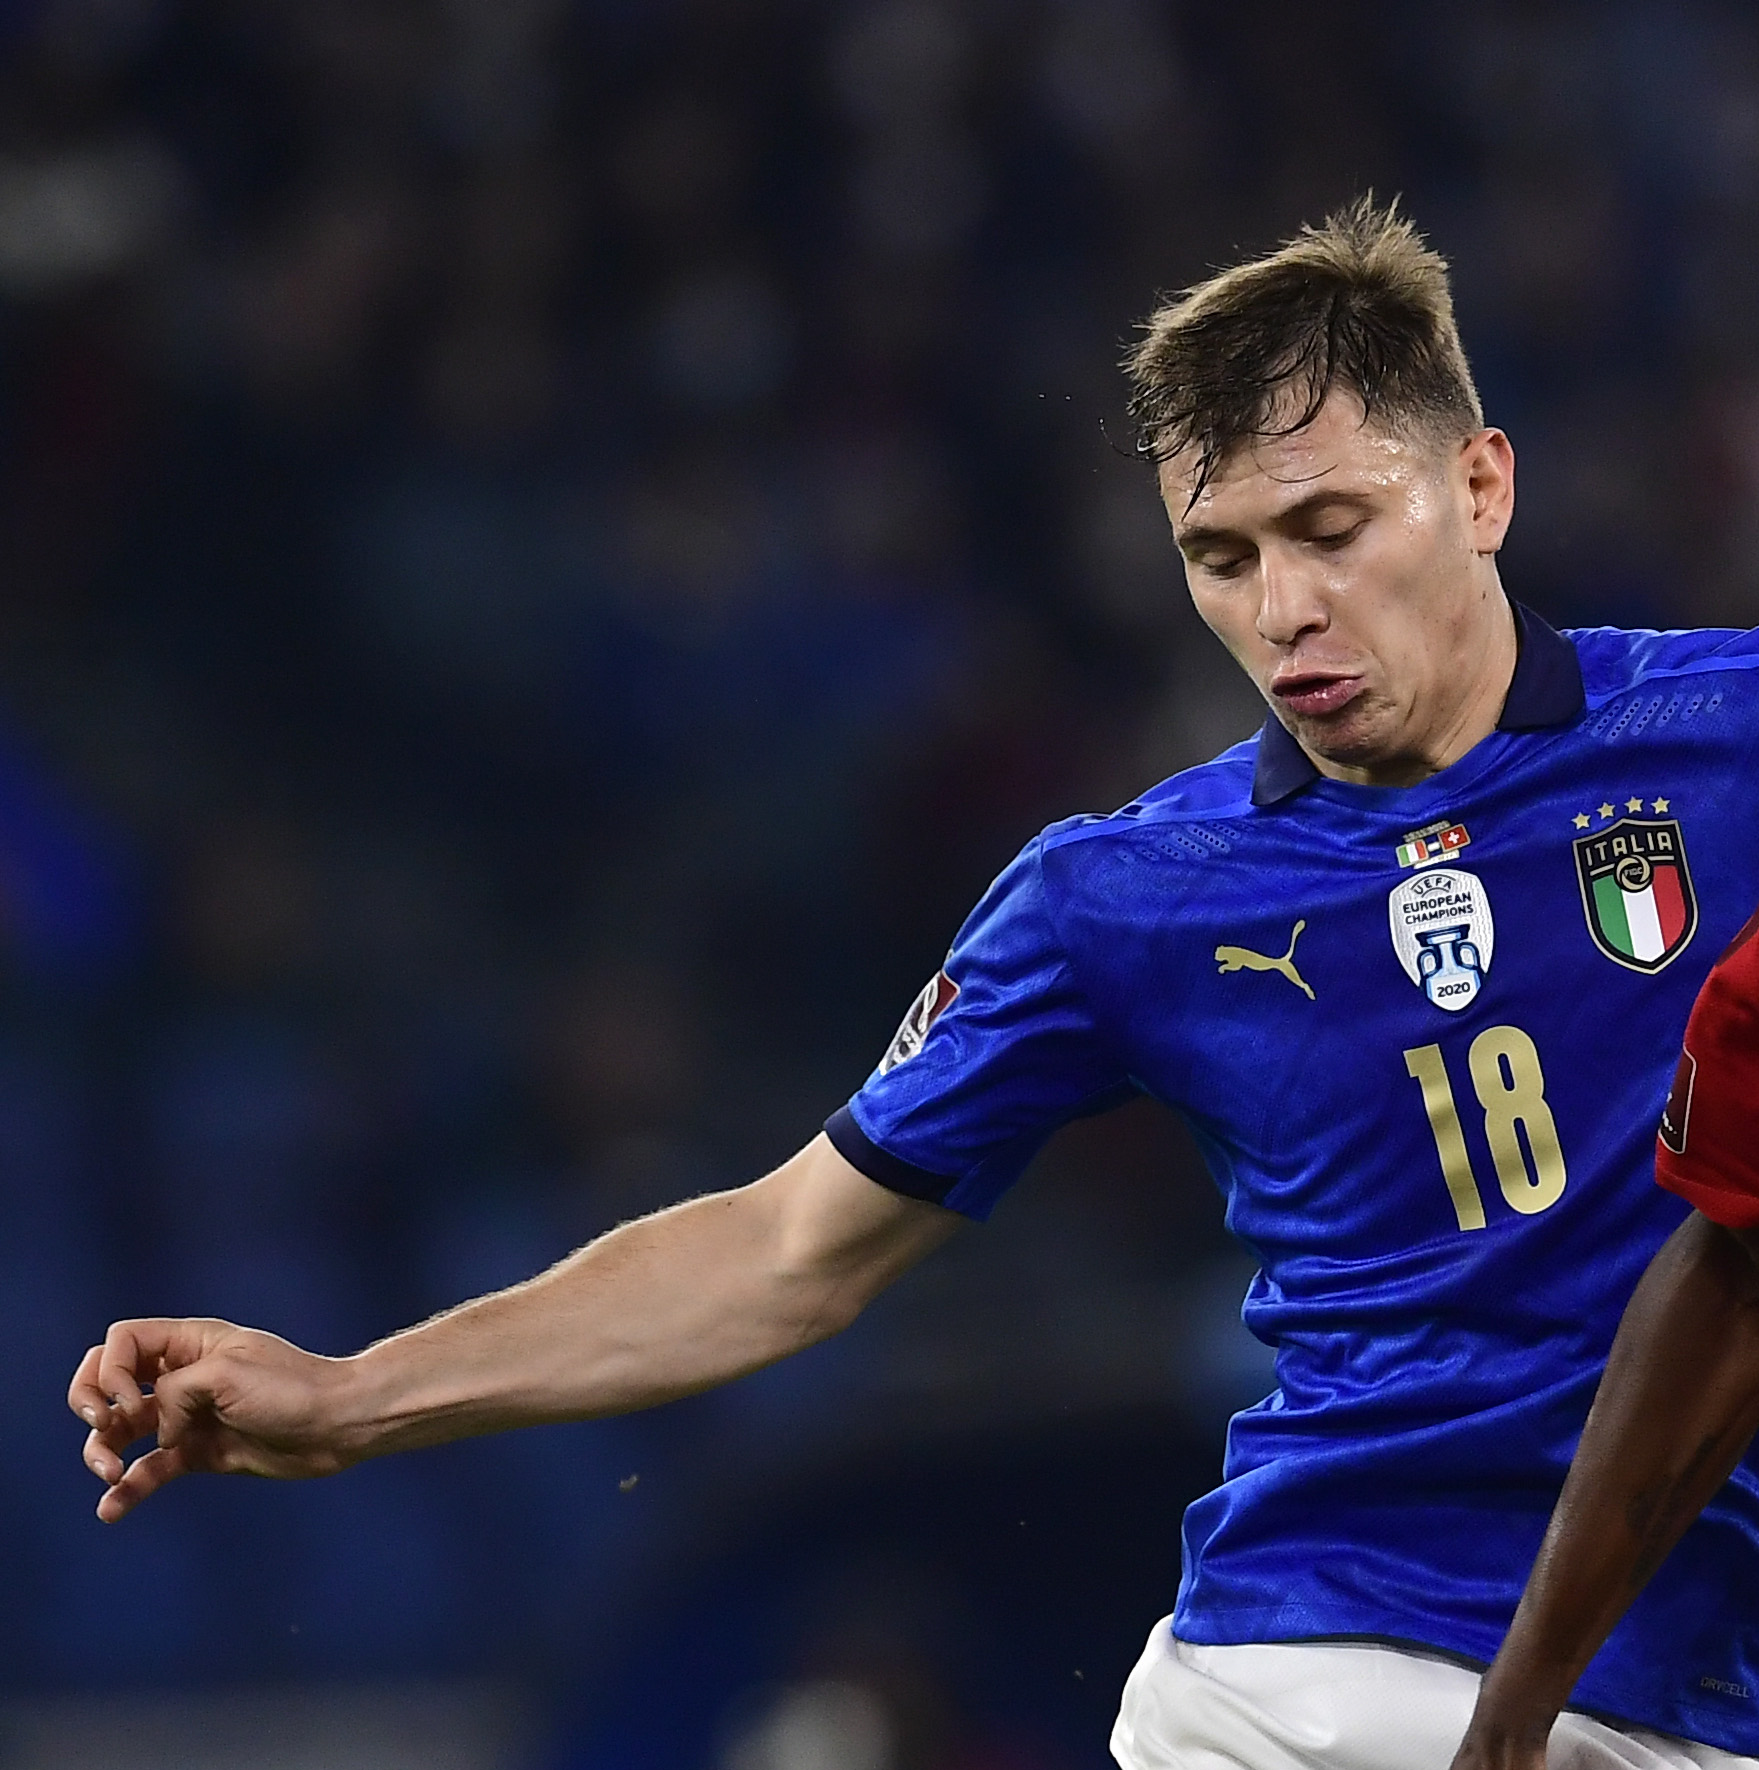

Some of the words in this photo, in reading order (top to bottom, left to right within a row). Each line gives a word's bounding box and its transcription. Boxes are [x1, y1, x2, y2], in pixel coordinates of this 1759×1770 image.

[1585, 831, 1673, 867] ITALIA
[1413, 877, 1452, 895] UEFA
[1402, 891, 1472, 914] EUROPEAN
[1405, 903, 1474, 925] CHAMPIONS
[1436, 981, 1471, 998] 2020
[1402, 1025, 1567, 1232] 18
